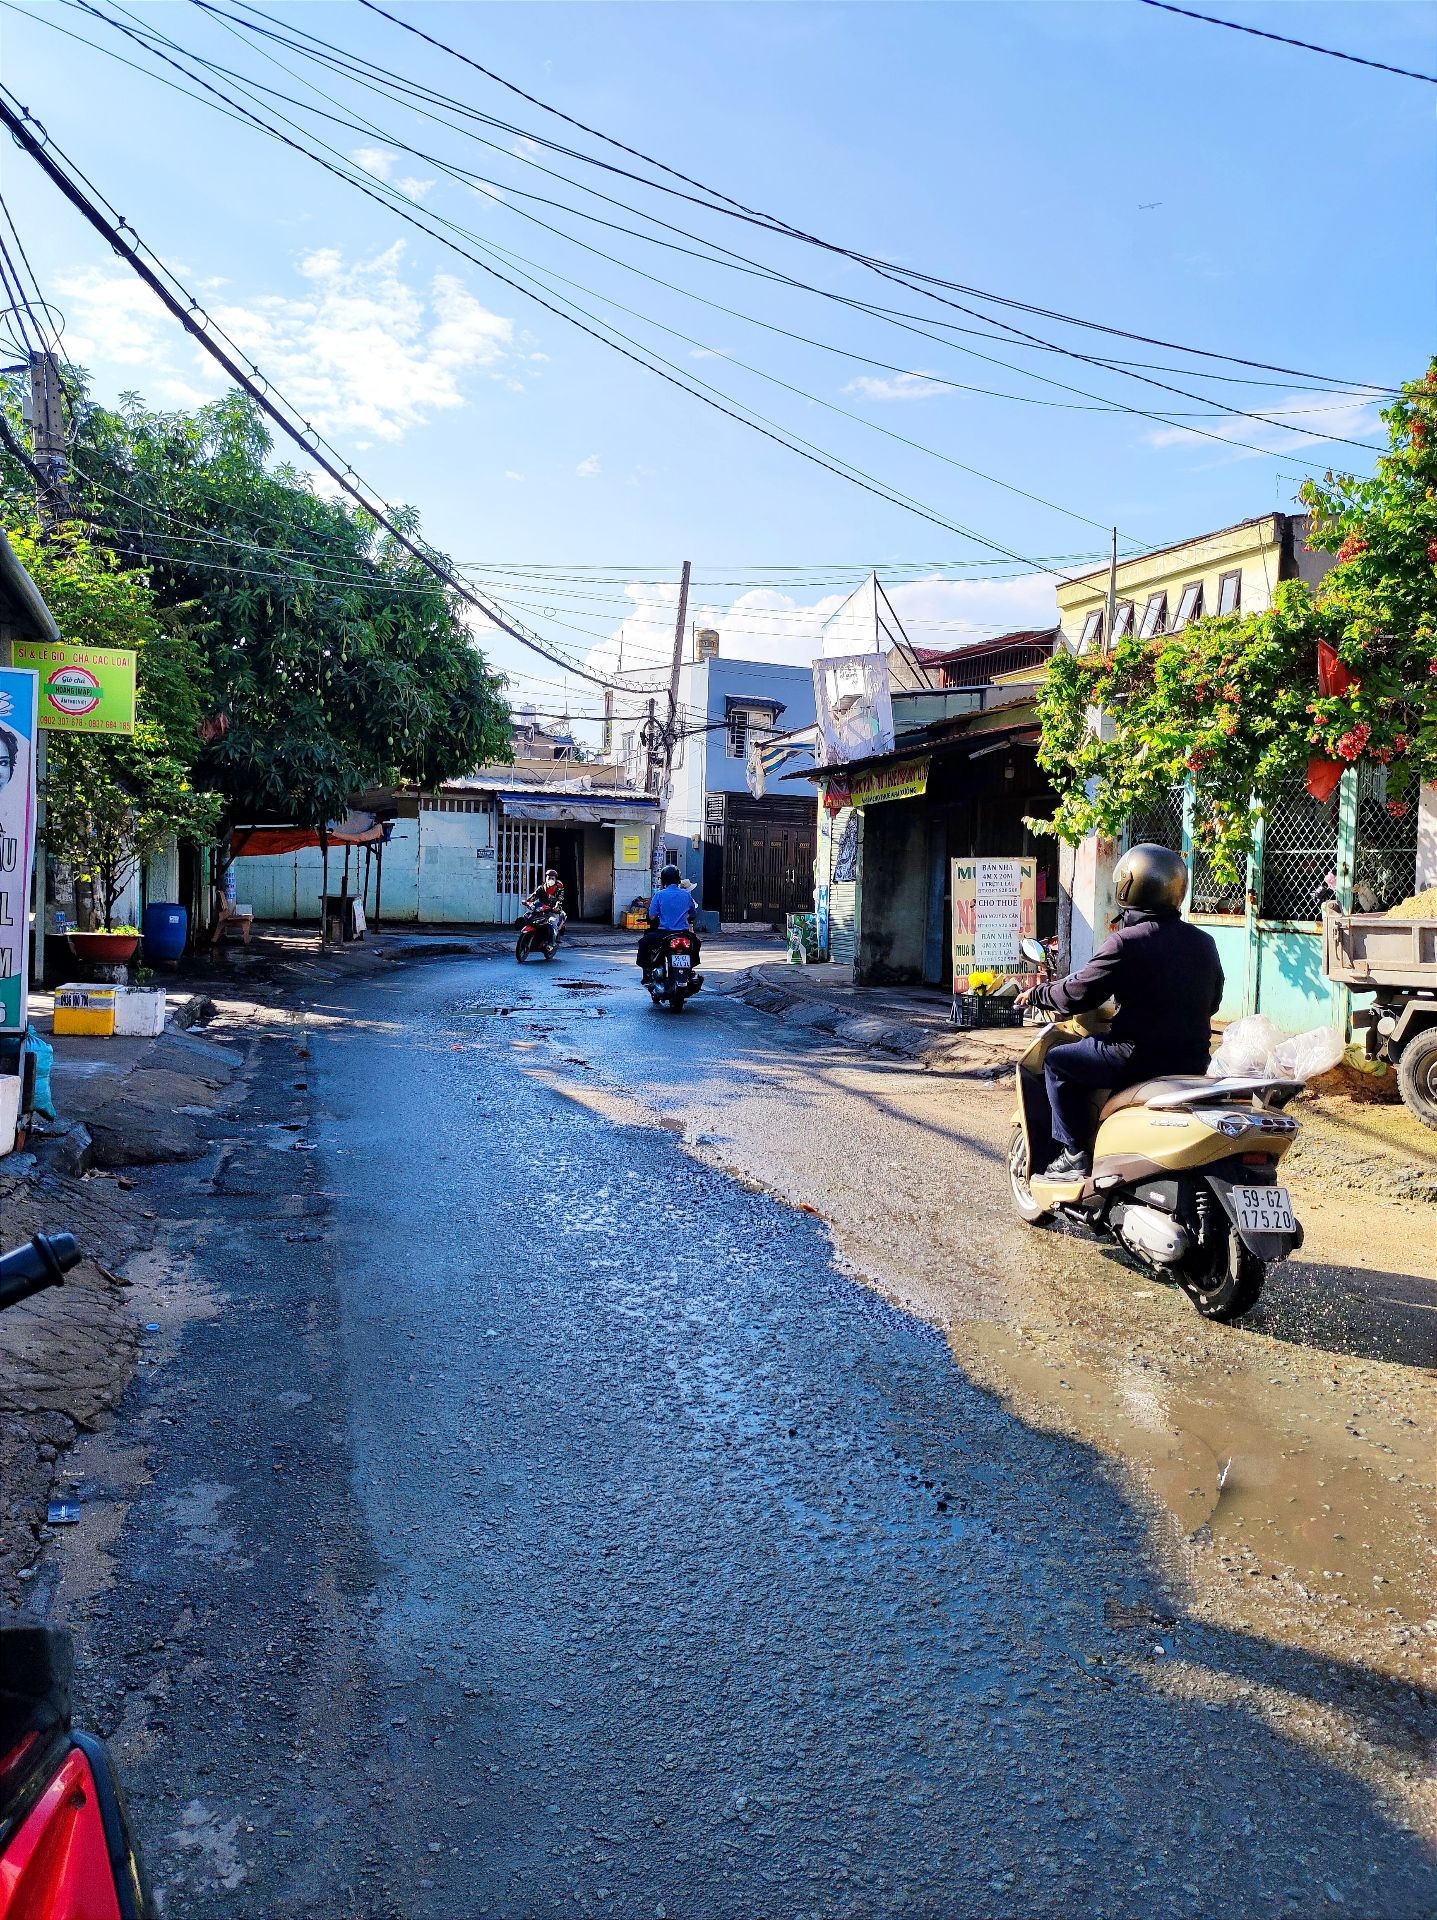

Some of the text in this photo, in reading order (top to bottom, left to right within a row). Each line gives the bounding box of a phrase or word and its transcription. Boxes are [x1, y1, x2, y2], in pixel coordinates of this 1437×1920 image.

[30, 650, 35, 658] &
[978, 897, 1018, 907] CHO THUÊ
[1242, 1190, 1283, 1208] 59-G2
[1241, 1210, 1291, 1229] 175.20
